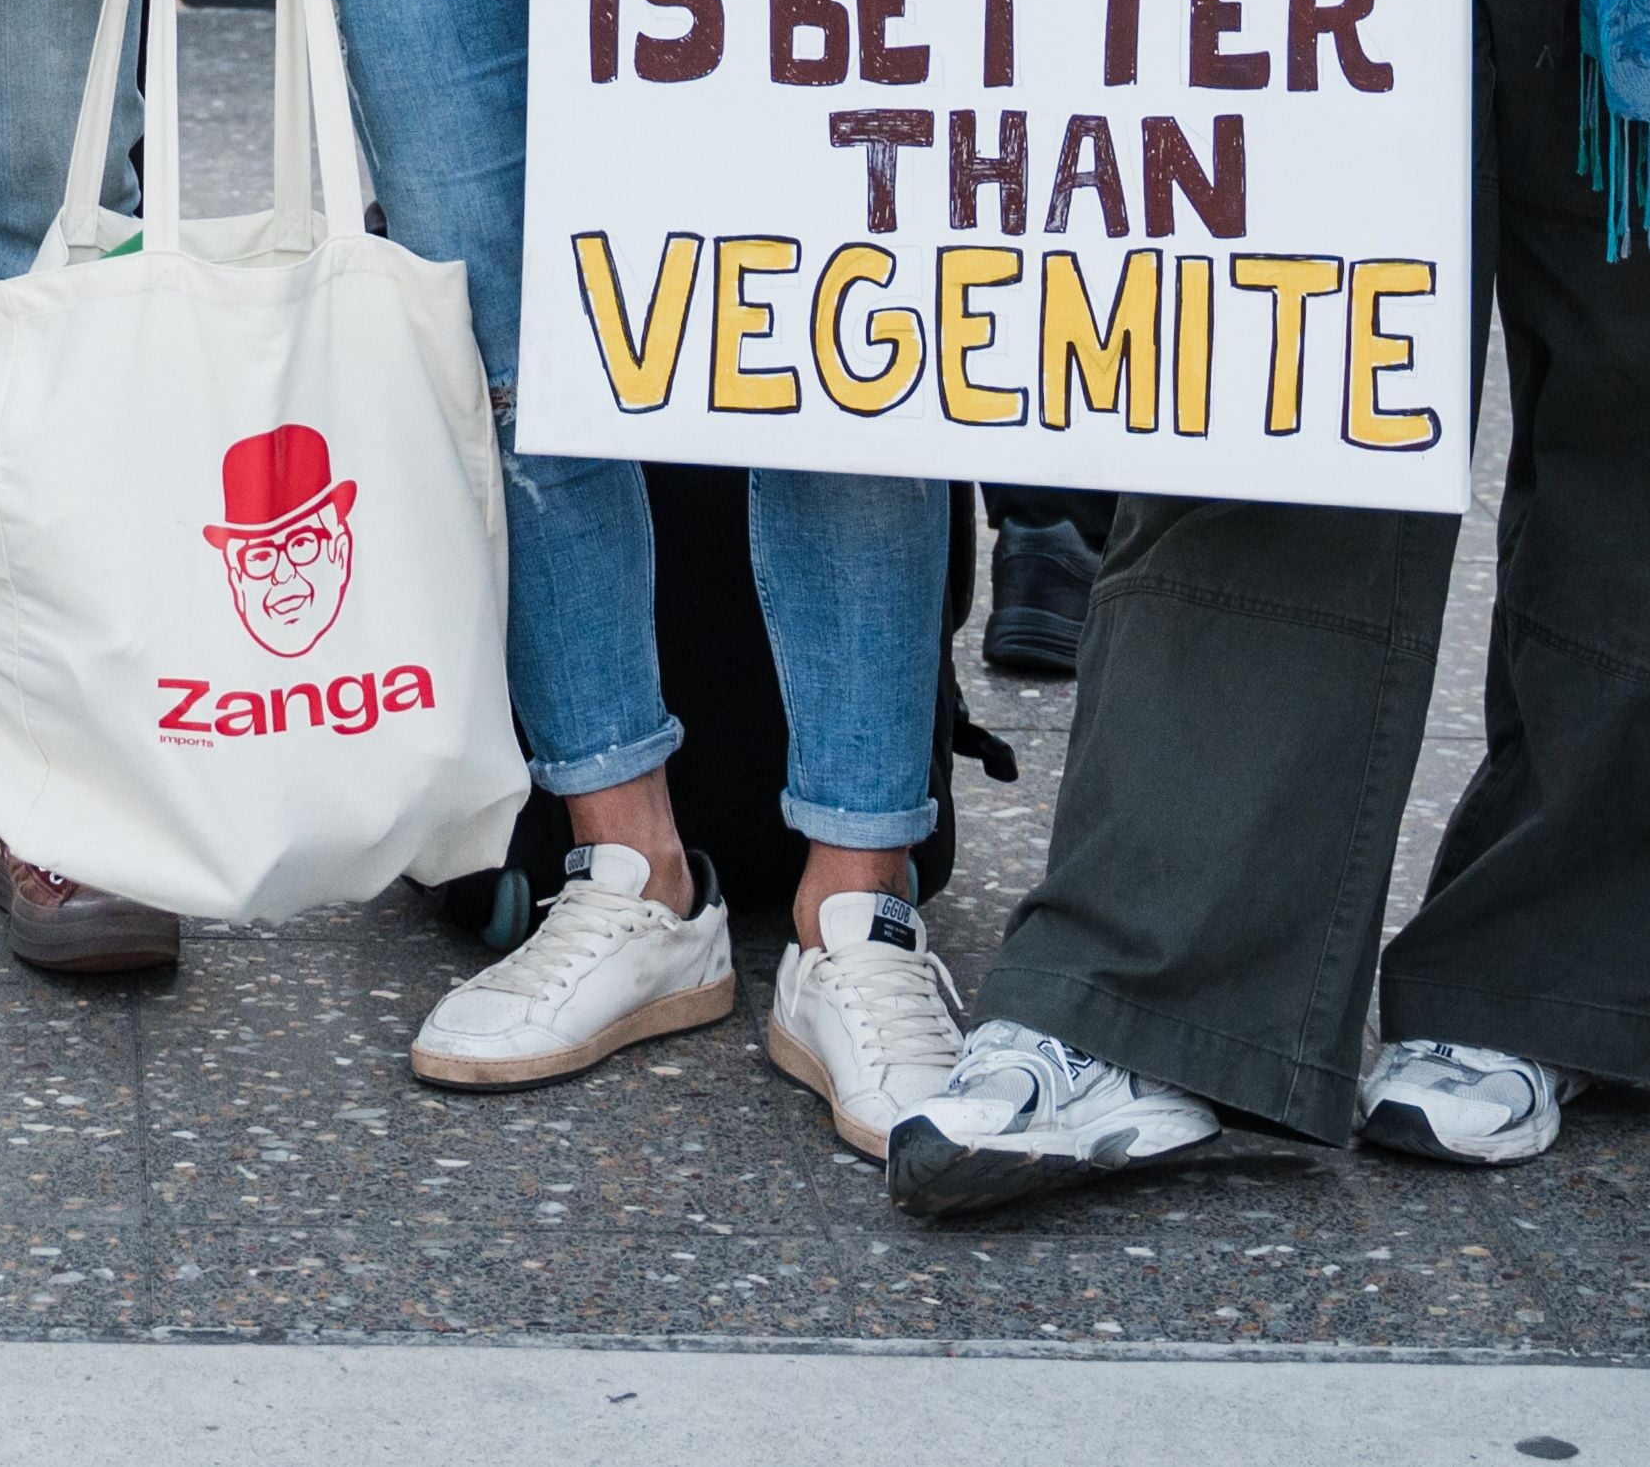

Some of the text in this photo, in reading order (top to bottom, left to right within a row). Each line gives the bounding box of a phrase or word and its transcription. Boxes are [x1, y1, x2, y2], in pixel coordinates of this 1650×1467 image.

[829, 109, 1248, 239] THAN
[570, 231, 1442, 451] VEGEMITE
[157, 663, 436, 737] Zanga
[881, 896, 912, 924] GGDB
